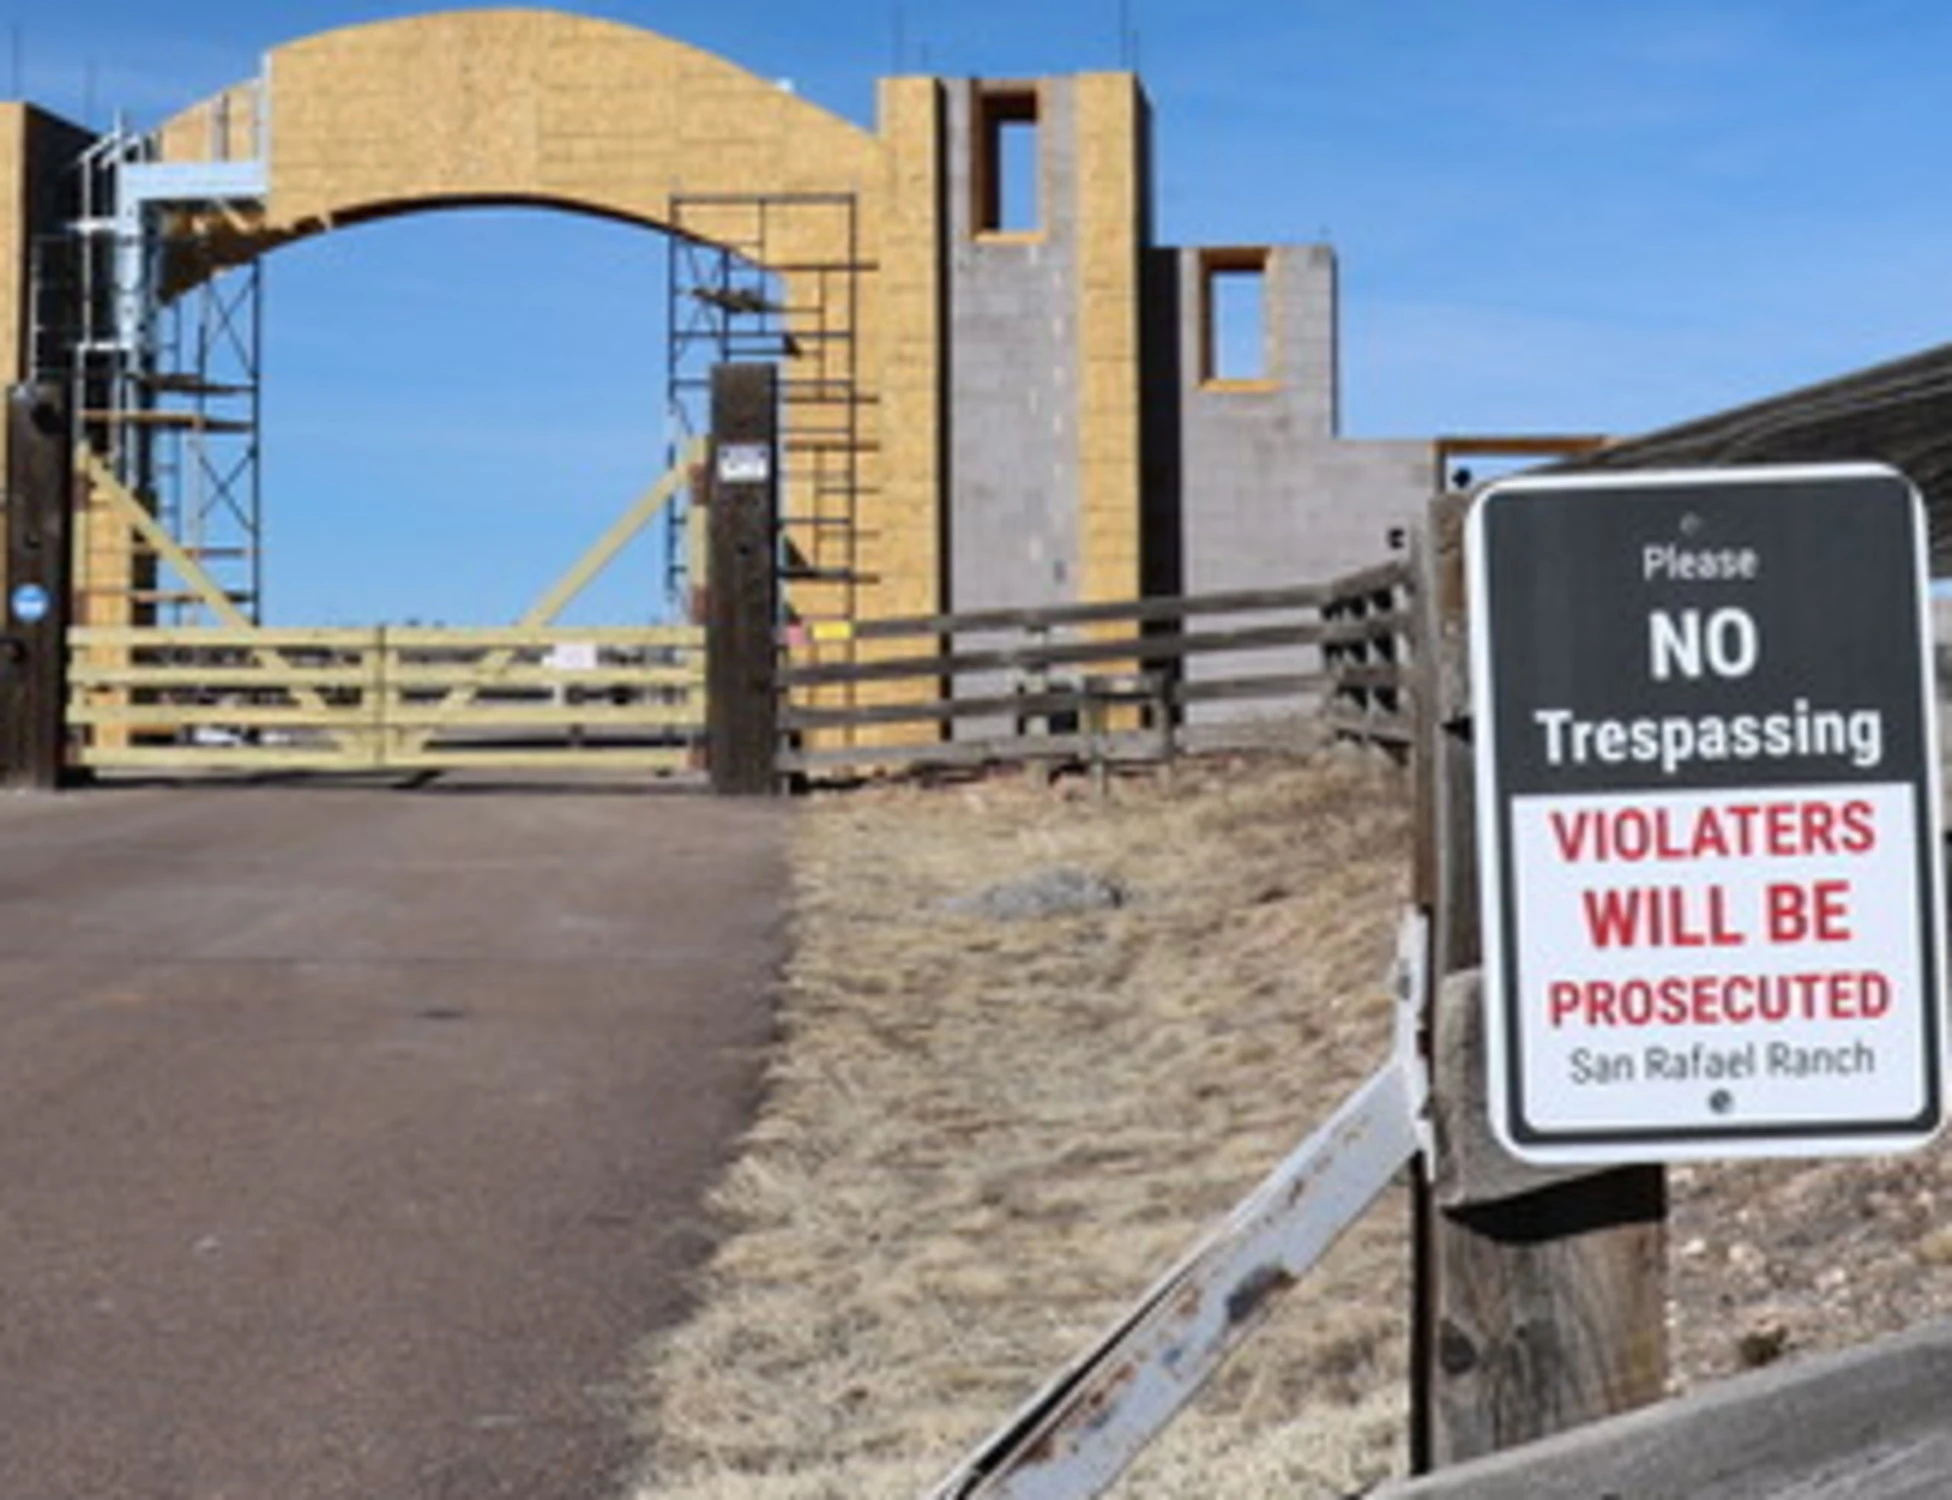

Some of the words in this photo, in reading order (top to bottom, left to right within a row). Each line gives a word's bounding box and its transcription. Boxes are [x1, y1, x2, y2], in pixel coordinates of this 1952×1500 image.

[1642, 545, 1759, 580] Please
[1649, 608, 1759, 680] NO
[1534, 699, 1883, 772] Trespassing
[1550, 800, 1876, 863] VIOLATERS
[1583, 884, 1745, 949] WILL
[1767, 880, 1852, 943] BE
[1548, 971, 1890, 1028] PROSECUTED
[1568, 1046, 1634, 1085] San
[1645, 1042, 1756, 1080] Rafael
[1767, 1039, 1875, 1076] Ranch
